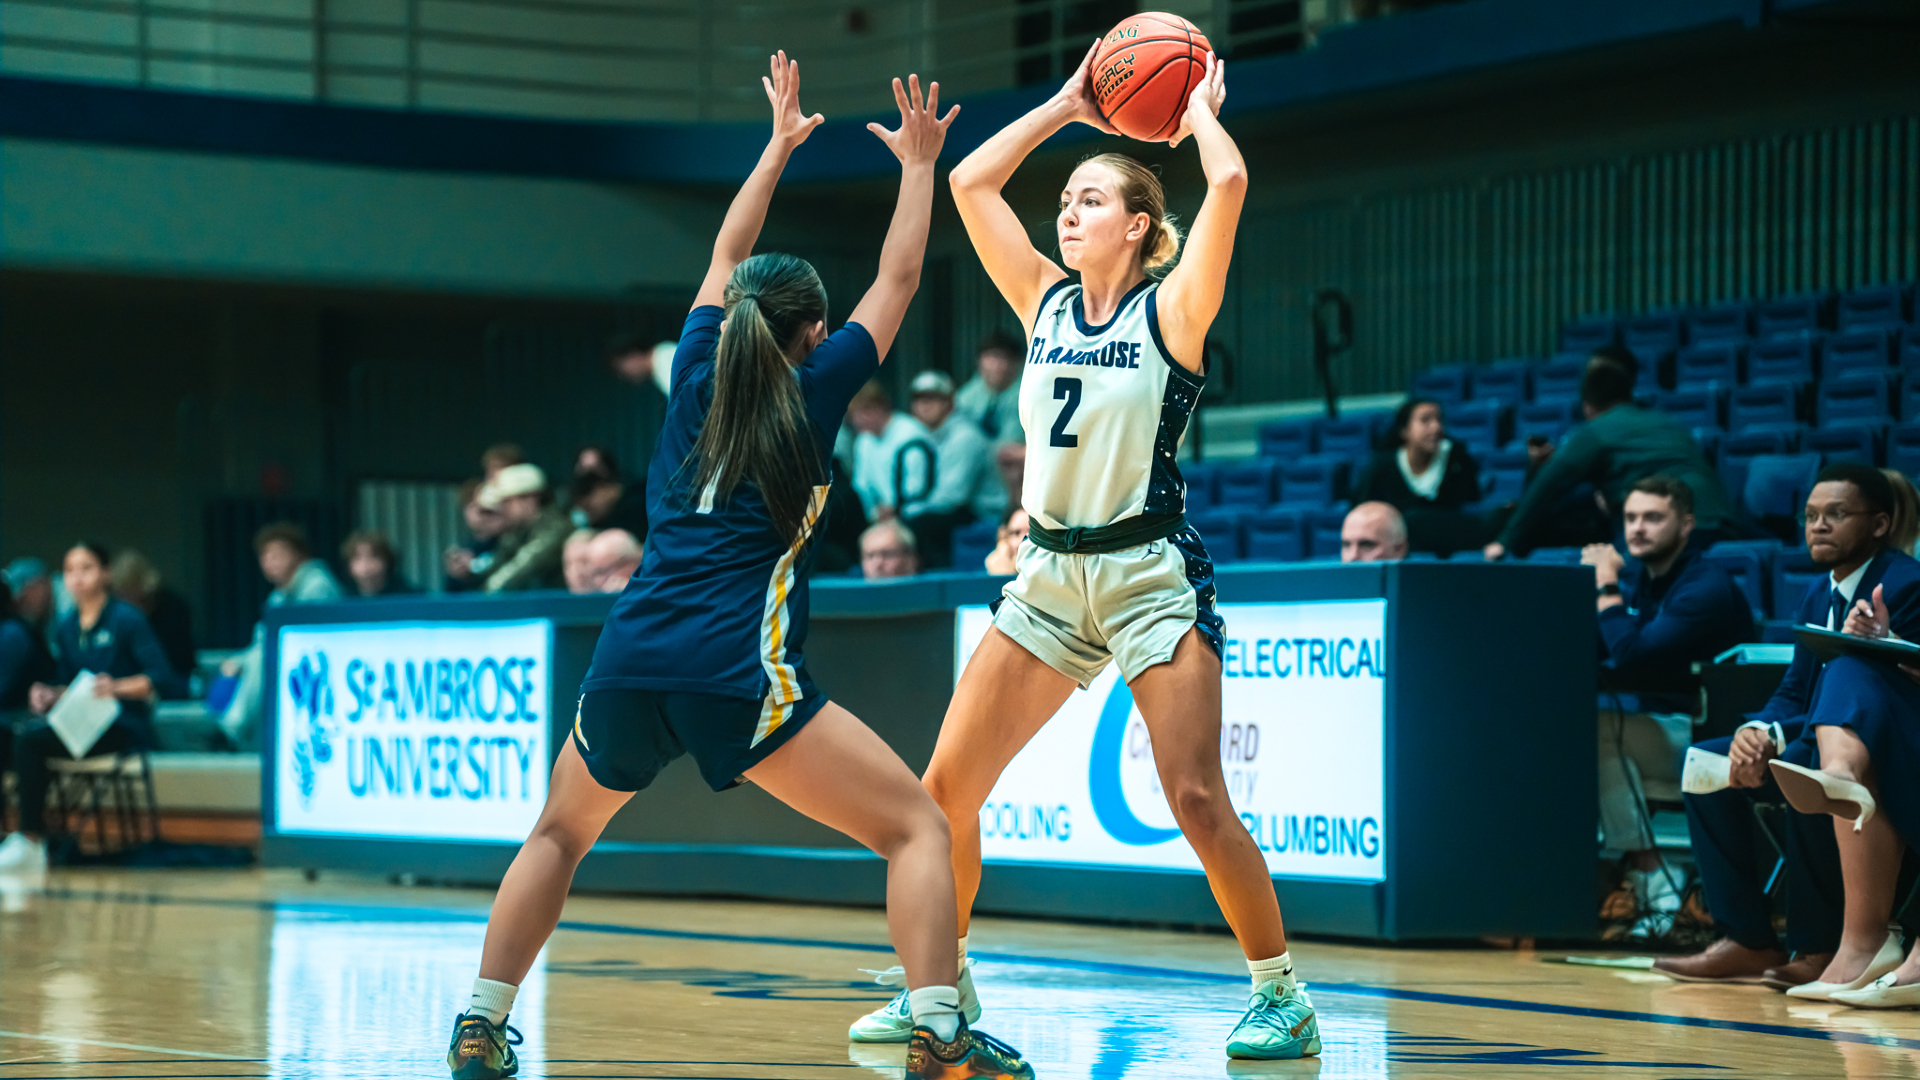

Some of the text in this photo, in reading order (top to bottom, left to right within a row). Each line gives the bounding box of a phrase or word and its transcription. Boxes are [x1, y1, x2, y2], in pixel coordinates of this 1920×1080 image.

[1095, 52, 1135, 97] EGACY
[1050, 377, 1082, 447] 2
[1225, 637, 1386, 679] ELECTRICAL
[378, 658, 538, 722] AMBROSE
[347, 735, 537, 800] UNIVERSITY
[980, 801, 1072, 841] OOLING
